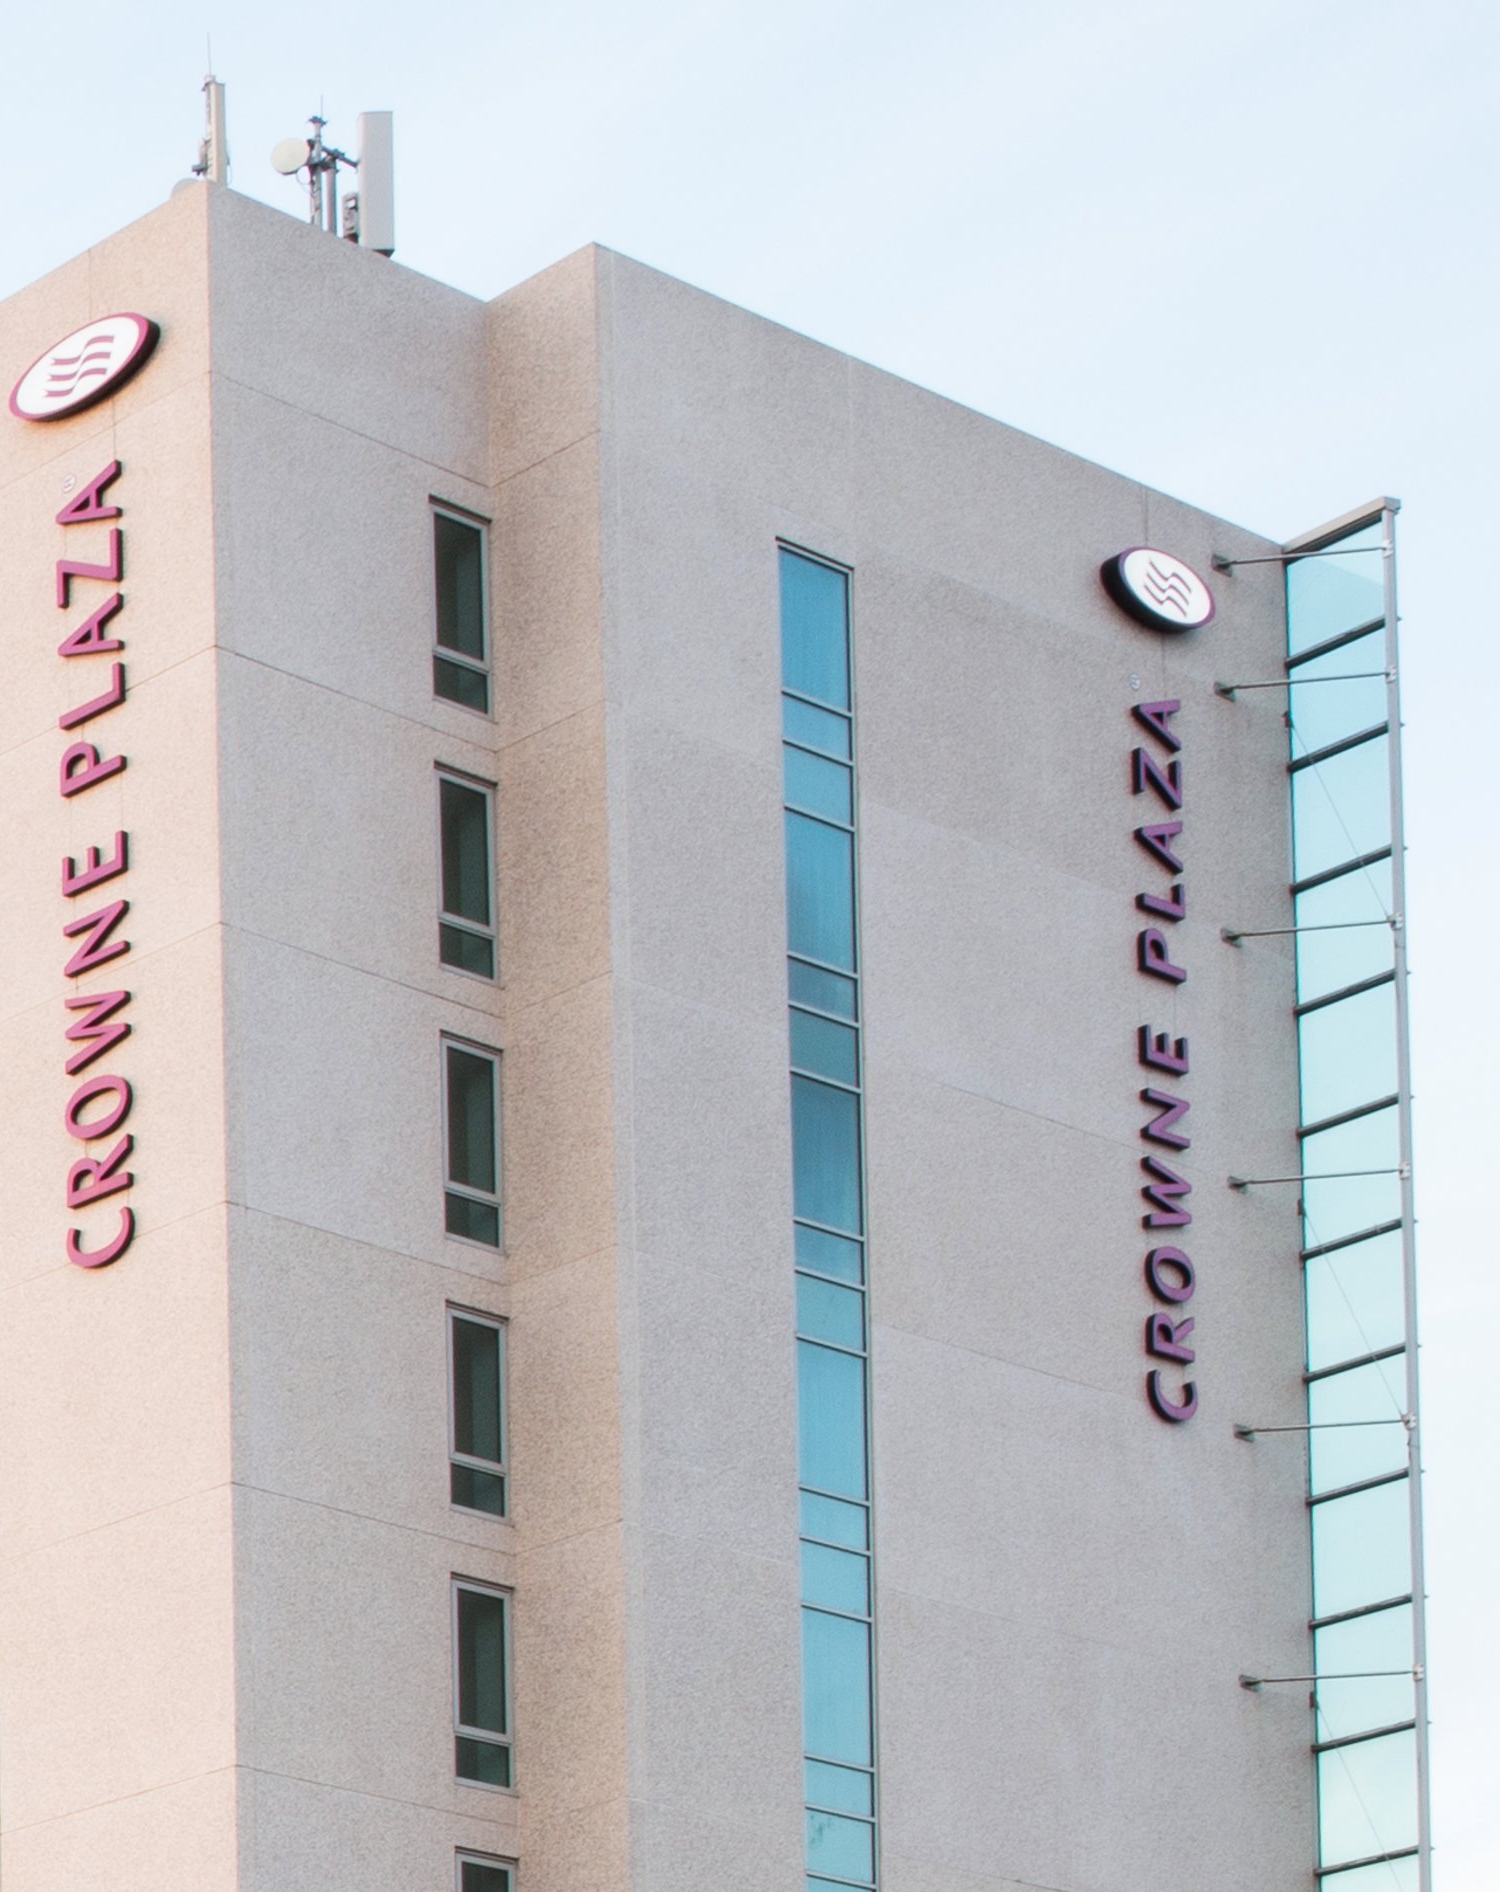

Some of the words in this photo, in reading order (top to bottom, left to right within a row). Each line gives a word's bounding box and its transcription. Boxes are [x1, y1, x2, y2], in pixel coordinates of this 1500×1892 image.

[56, 458, 128, 800] PLAZA
[1131, 696, 1189, 987] PLAZA
[62, 829, 135, 1271] CROWNE
[1138, 1022, 1200, 1427] CROWNE
